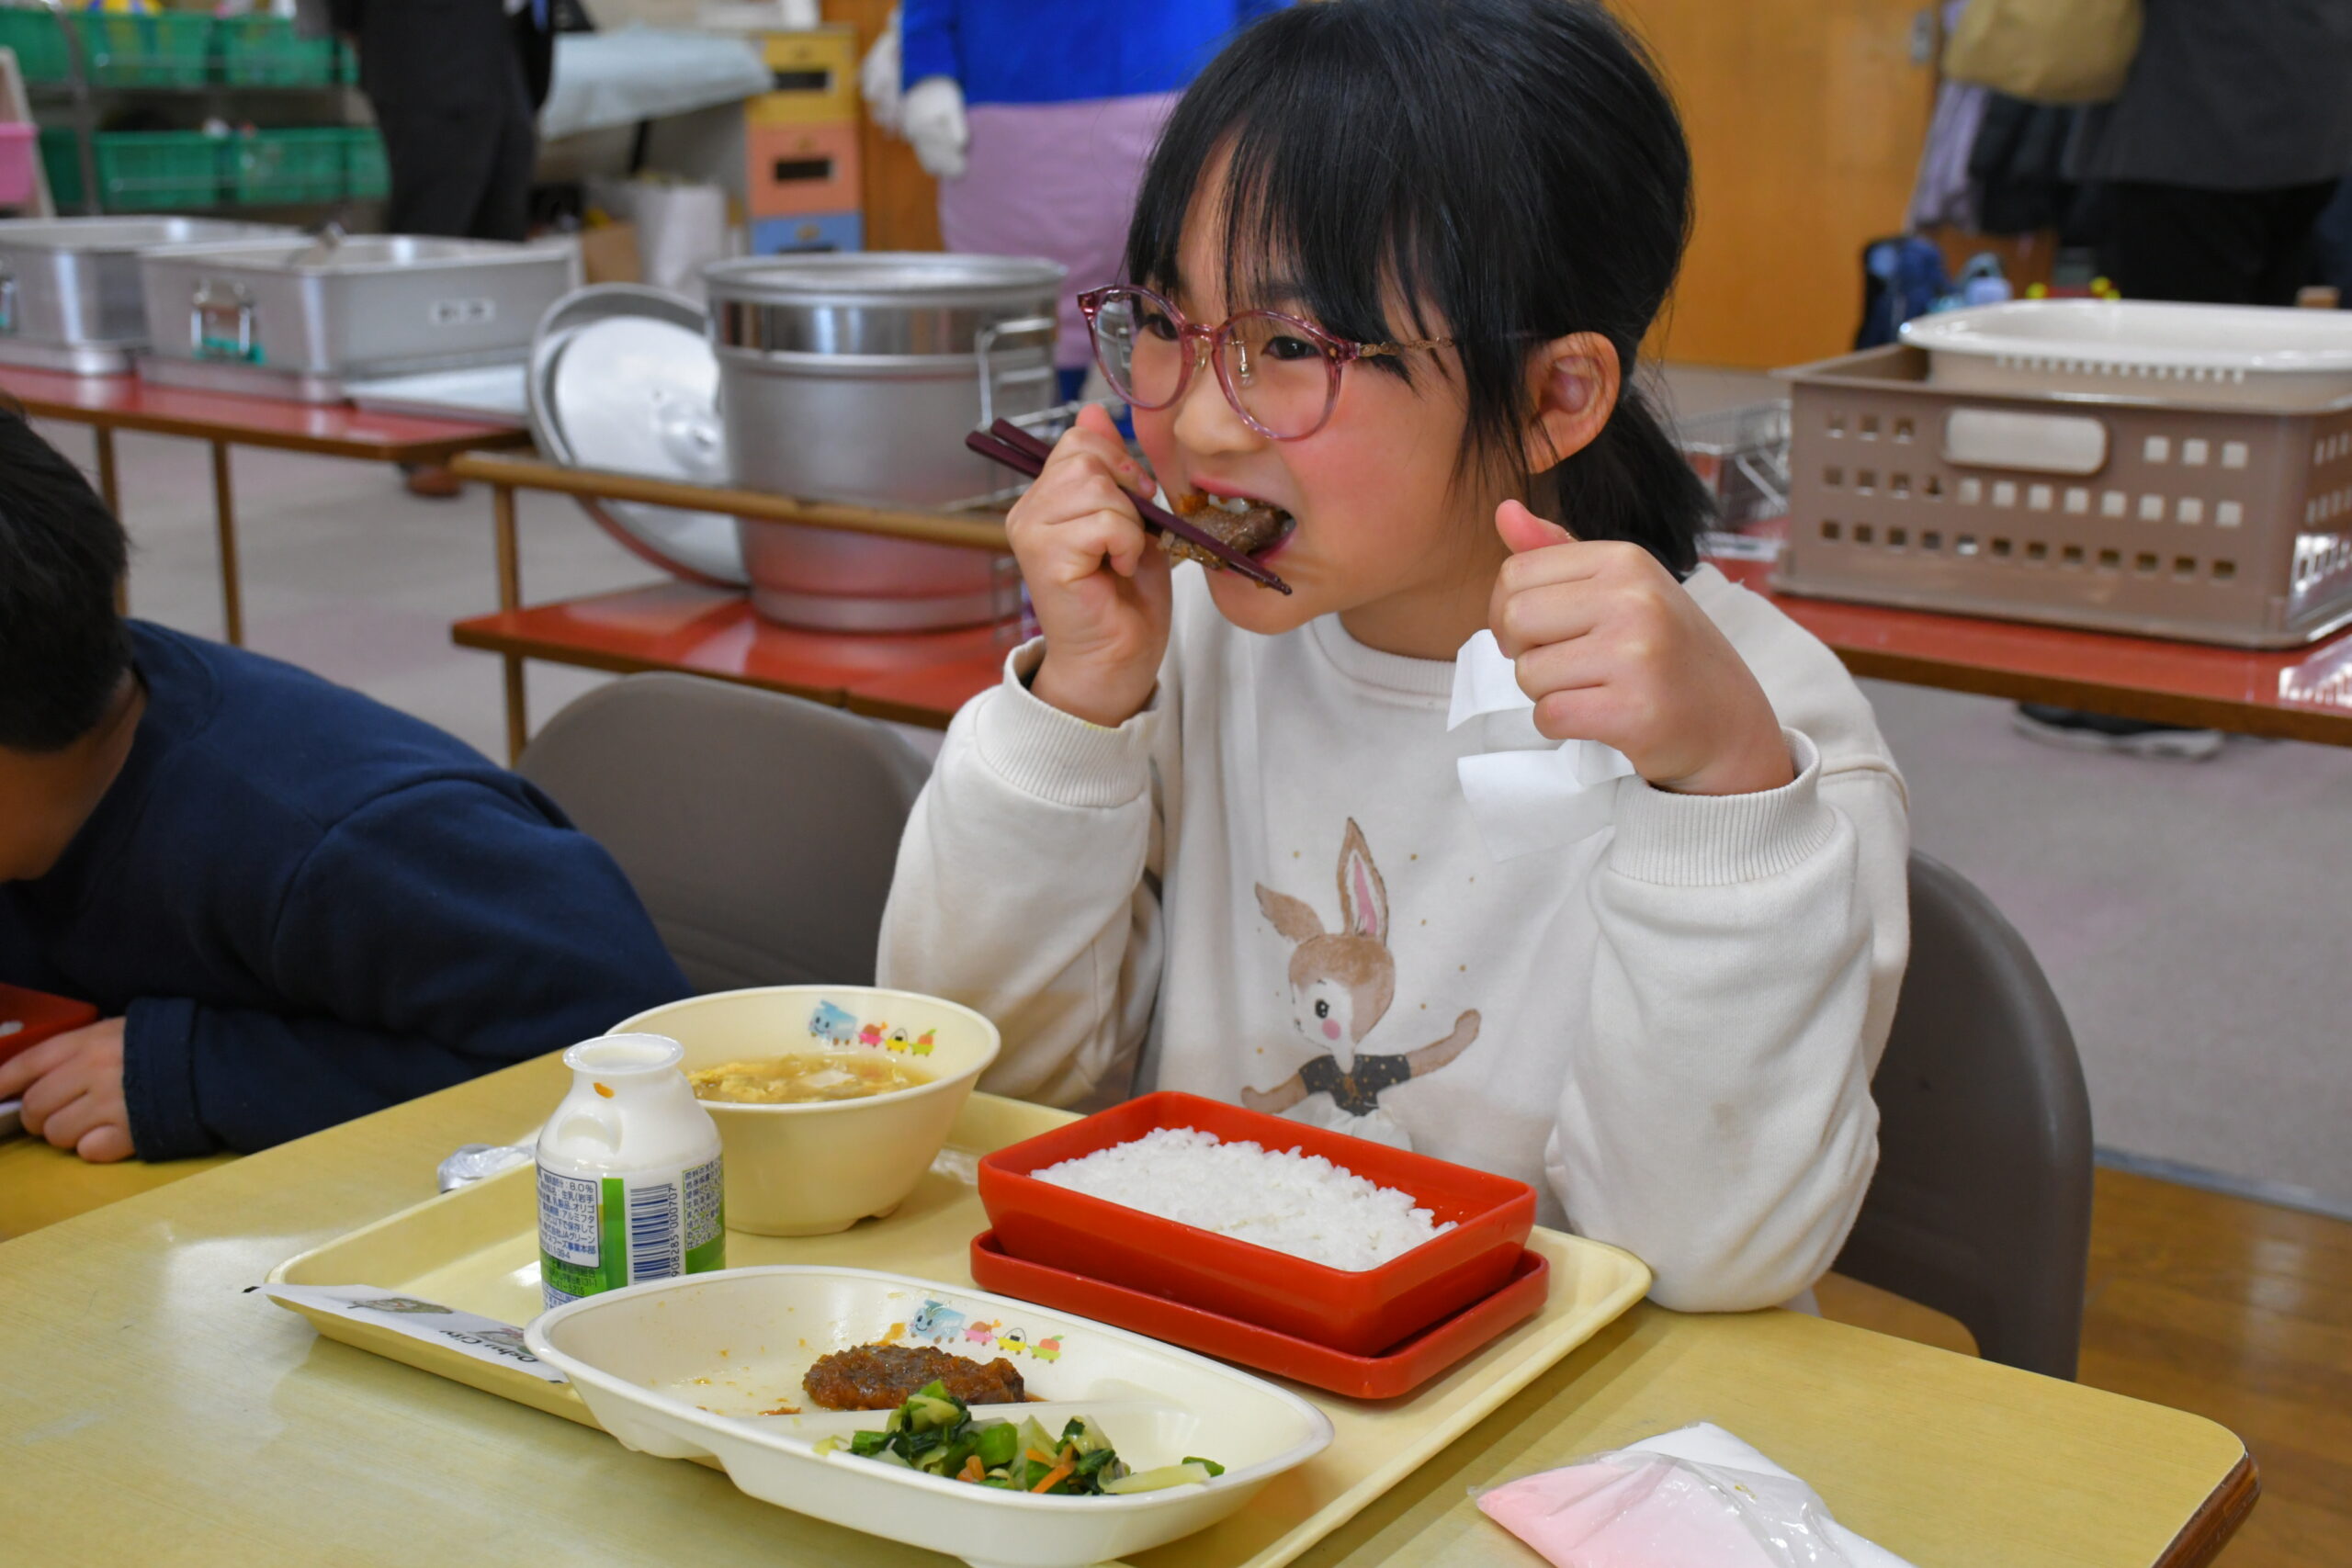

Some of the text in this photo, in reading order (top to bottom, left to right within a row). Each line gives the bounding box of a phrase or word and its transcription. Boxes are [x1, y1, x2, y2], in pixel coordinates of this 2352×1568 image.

[668, 1187, 678, 1229] 000707
[438, 1330, 539, 1363] Oshu City
